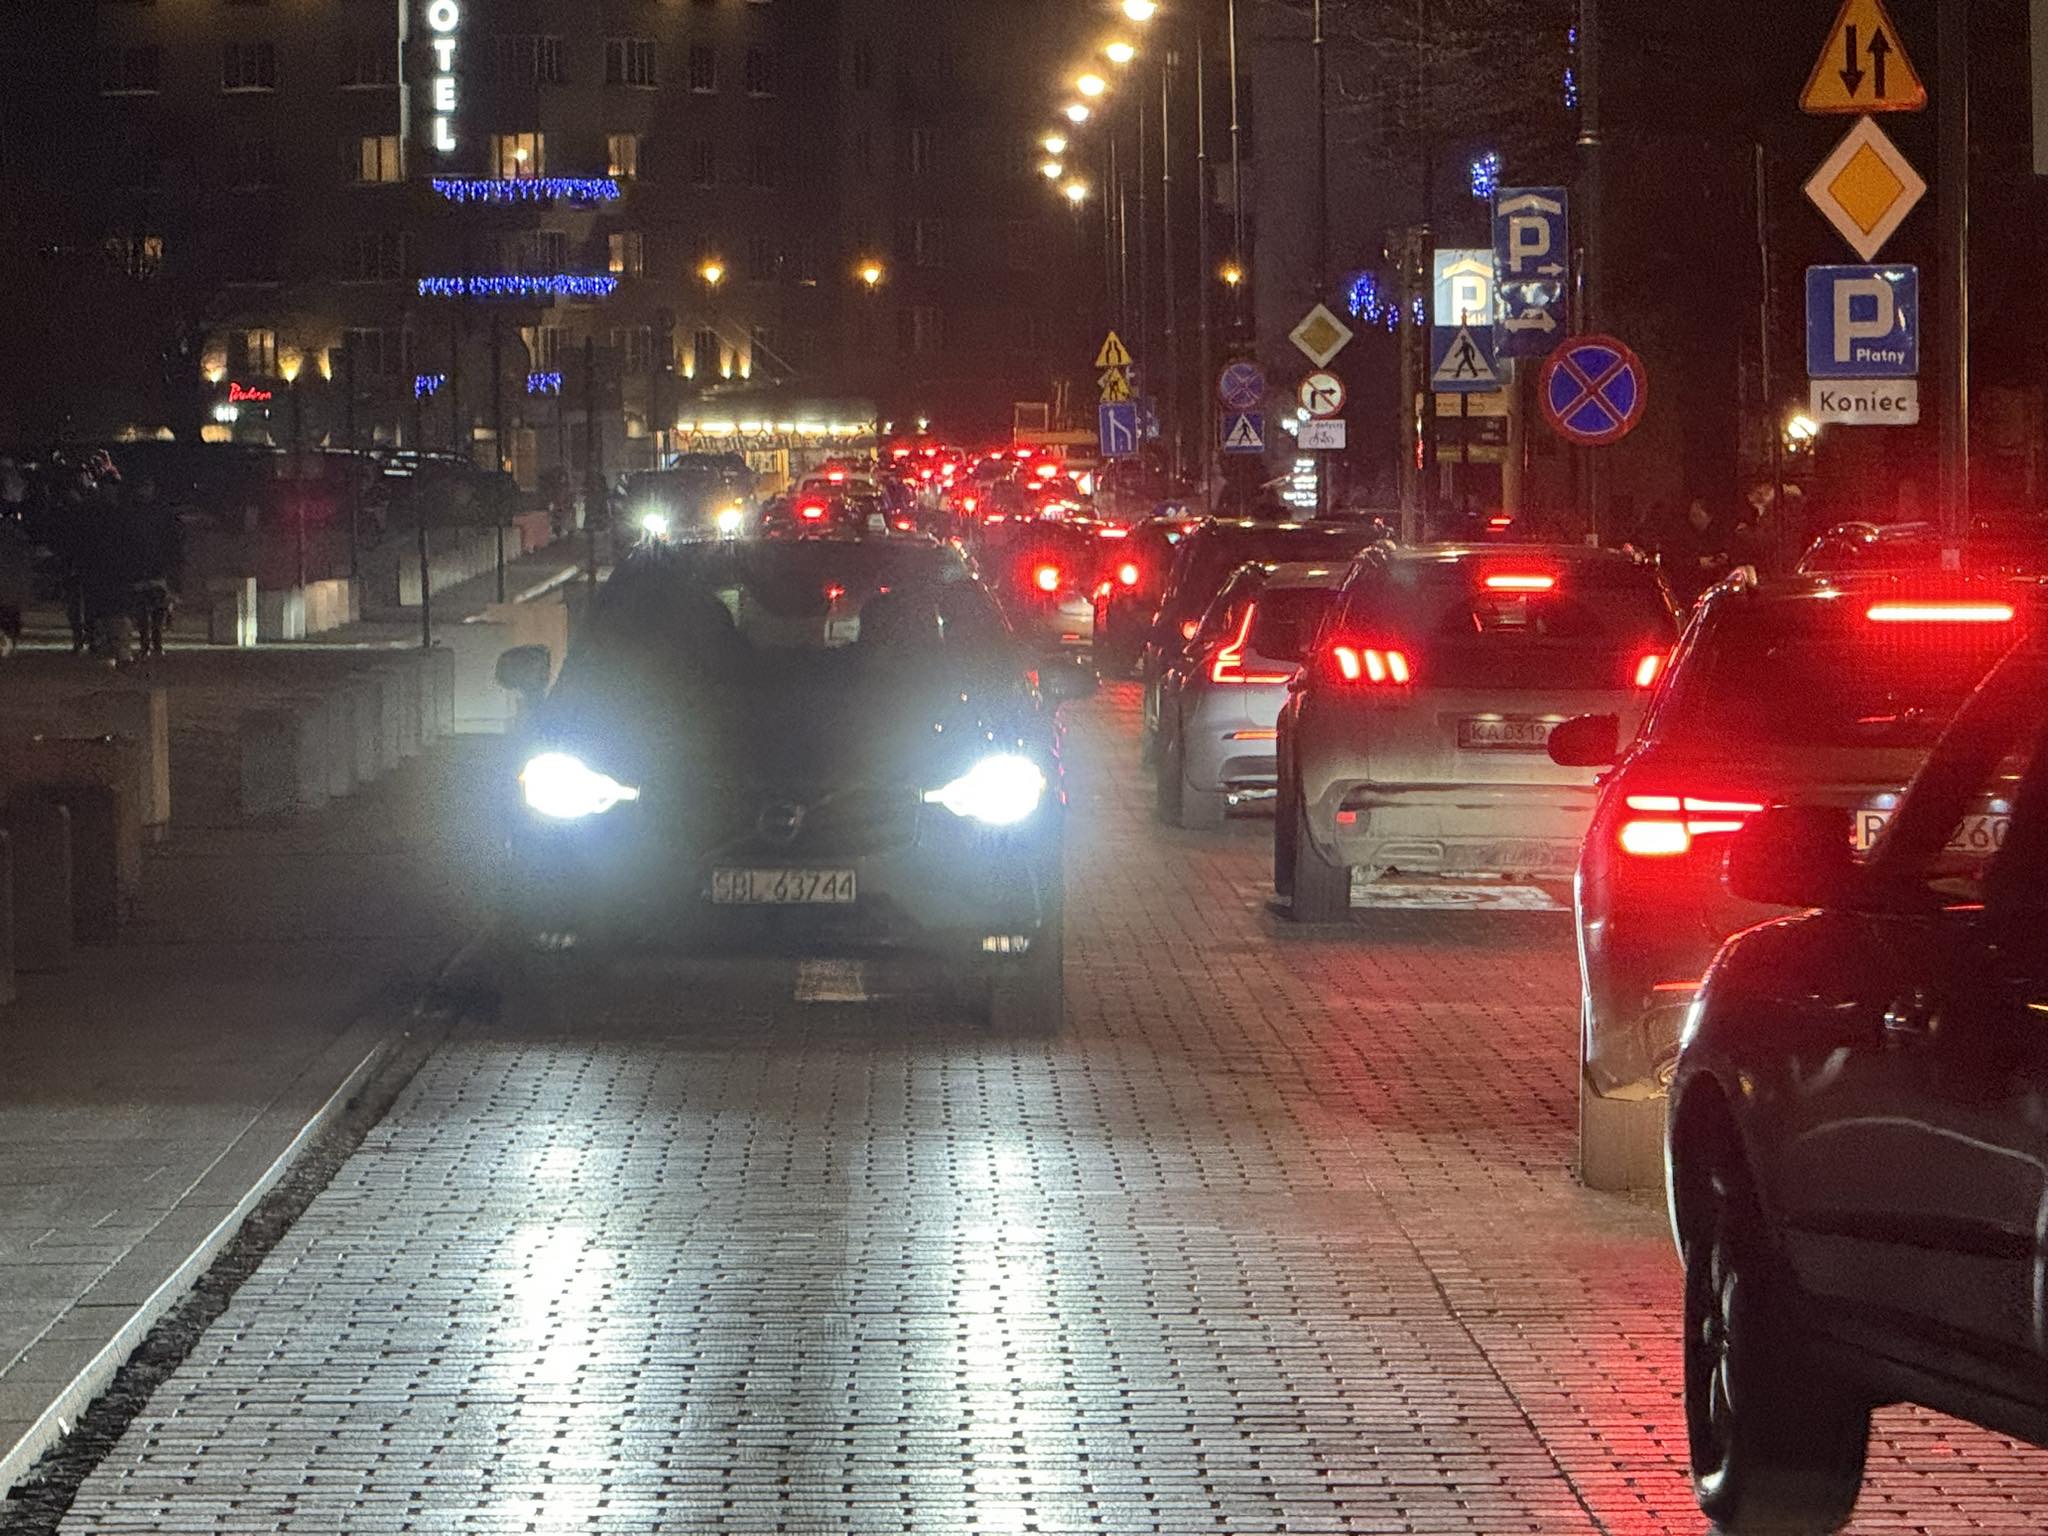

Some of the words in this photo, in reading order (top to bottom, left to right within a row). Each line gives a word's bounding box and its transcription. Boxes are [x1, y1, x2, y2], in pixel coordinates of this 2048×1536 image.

[1510, 216, 1549, 272] P
[1452, 276, 1486, 326] P
[1834, 279, 1894, 362] P
[1820, 391, 1906, 412] Koniec
[1472, 723, 1498, 740] KA
